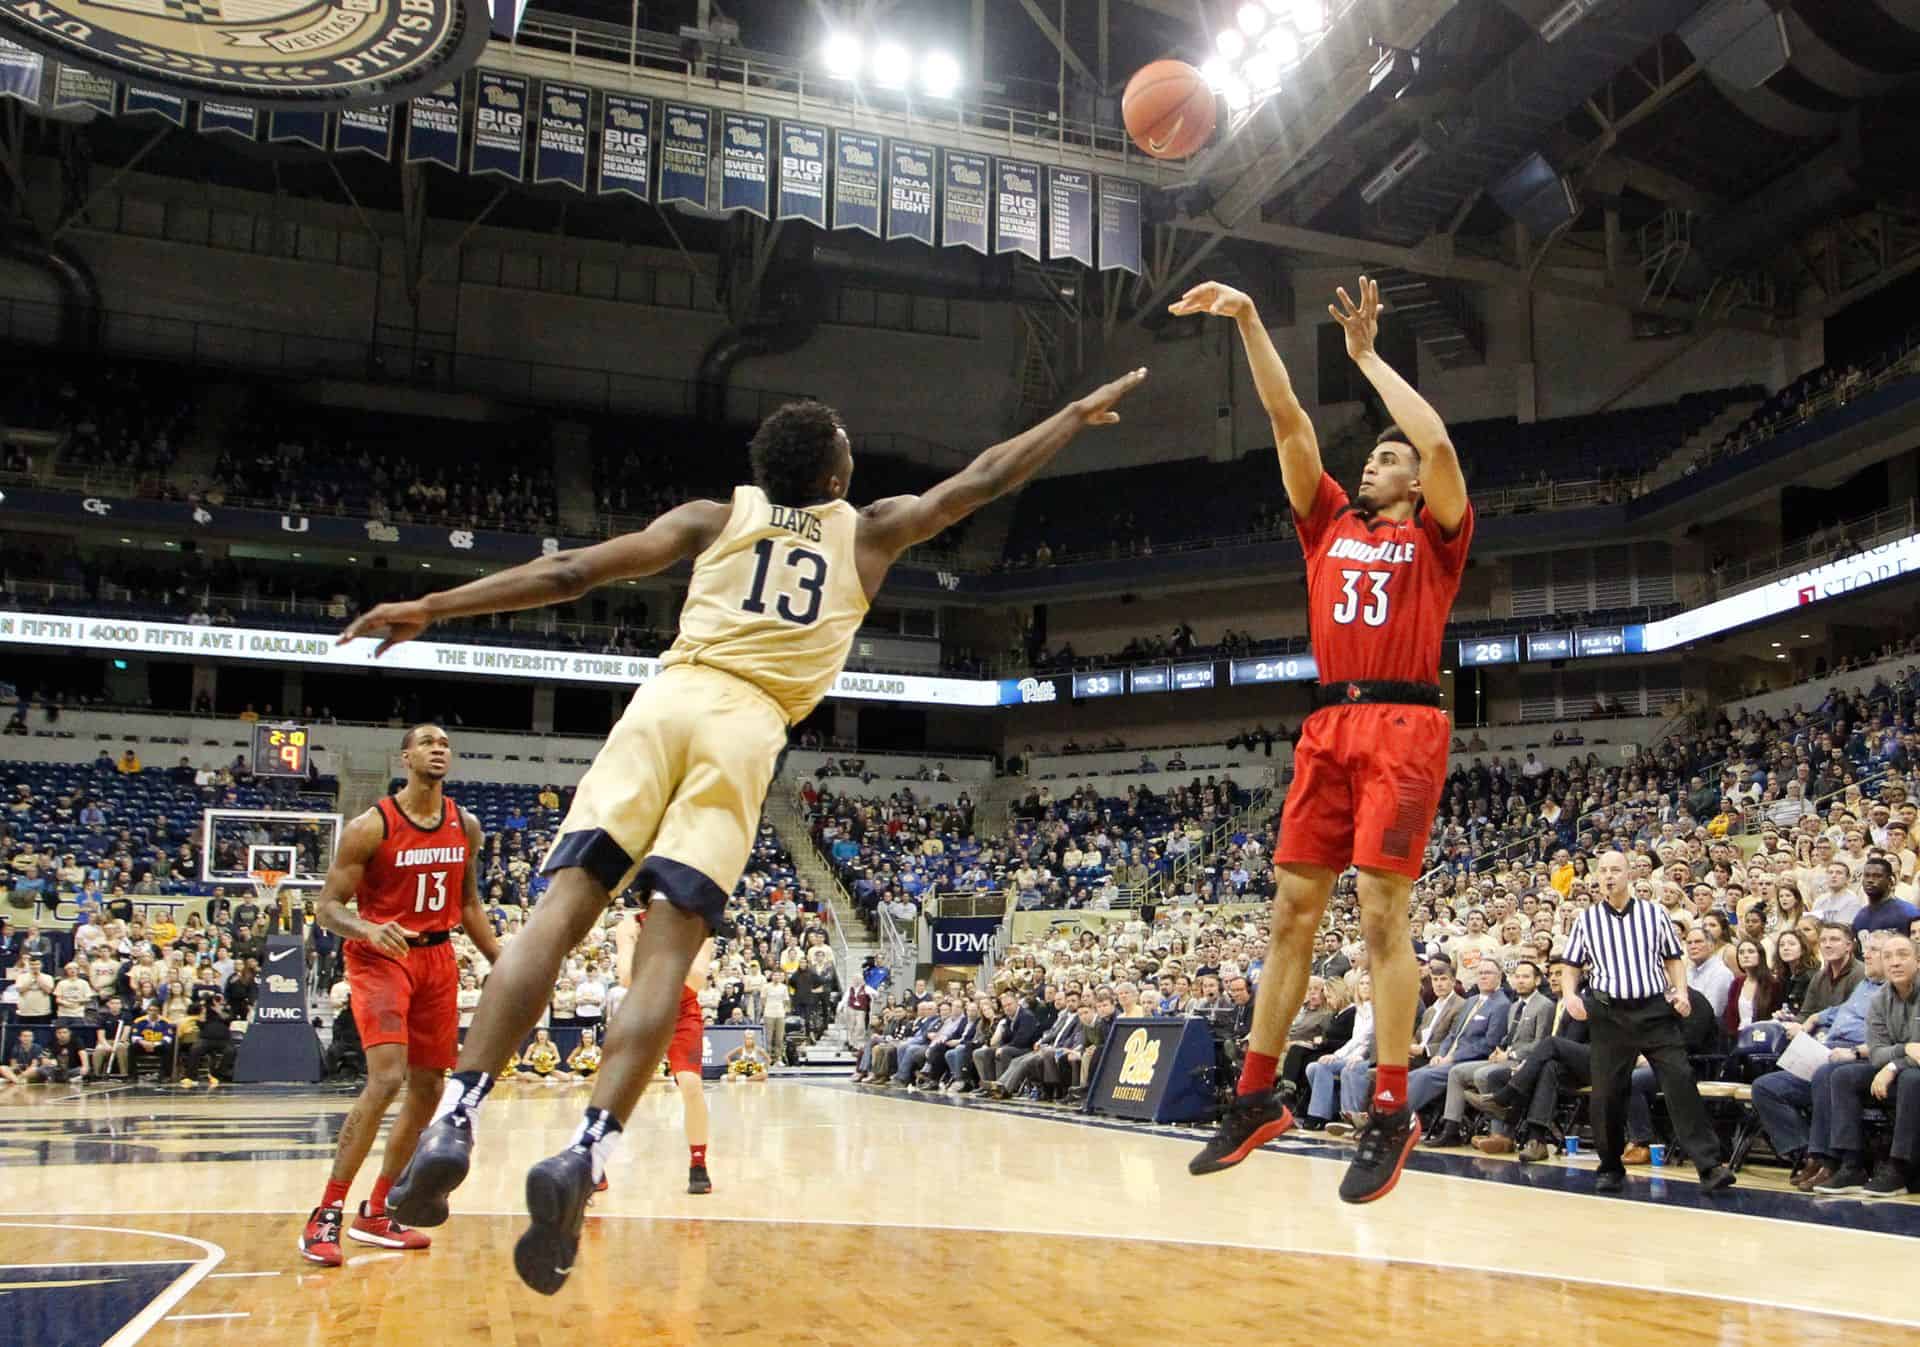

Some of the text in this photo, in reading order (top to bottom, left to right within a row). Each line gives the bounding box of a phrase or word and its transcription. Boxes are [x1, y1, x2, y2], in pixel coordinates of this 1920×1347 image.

[278, 13, 357, 49] VERITAS
[413, 97, 458, 111] NCAA
[343, 110, 388, 126] WEST
[412, 108, 458, 124] SWEET
[478, 108, 522, 126] BIG
[412, 118, 458, 133] SIXTEEN
[477, 120, 521, 135] EAST
[541, 117, 585, 132] NCAA
[541, 129, 585, 145] SWEET
[605, 129, 648, 147] BIG
[541, 139, 585, 155] SIXTEEN
[605, 142, 647, 156] EAST
[724, 147, 765, 161] NCAA
[603, 153, 646, 167] REGULAR
[724, 159, 766, 174] SWEET
[783, 157, 823, 174] BIG
[603, 161, 646, 176] SEASON
[724, 169, 766, 183] SIXTEEN
[783, 169, 823, 183] EAST
[893, 176, 930, 190] NCAA
[1059, 173, 1081, 183] NIT
[892, 188, 931, 203] ELITE
[1000, 193, 1037, 209] BIG
[891, 199, 931, 215] EIGHT
[1000, 205, 1036, 217] EAST
[281, 515, 309, 532] U
[769, 505, 822, 543] DAVIS
[741, 537, 828, 626] 13
[1333, 569, 1393, 627] 33
[20, 619, 72, 638] FIFTH
[90, 624, 139, 643] 4000
[145, 628, 194, 648] FIFTH
[200, 632, 233, 650] AVE
[251, 635, 329, 656] OAKLAND
[1557, 640, 1567, 650] 4
[1606, 636, 1621, 646] 10
[1476, 643, 1502, 662] 26
[436, 648, 467, 667] THE
[473, 651, 568, 674] UNIVERSITY
[573, 658, 622, 677] STORE
[628, 661, 649, 678] ON
[1255, 660, 1299, 679] 2:10
[1198, 670, 1211, 681] 10
[841, 677, 905, 695] OAKLAND
[1087, 677, 1109, 693] 33
[270, 730, 305, 747] 2:10
[281, 745, 298, 771] 9
[394, 845, 465, 867] LOUISVILLE
[414, 871, 448, 913] 13
[936, 933, 992, 952] UPM
[259, 1007, 302, 1019] UPMC
